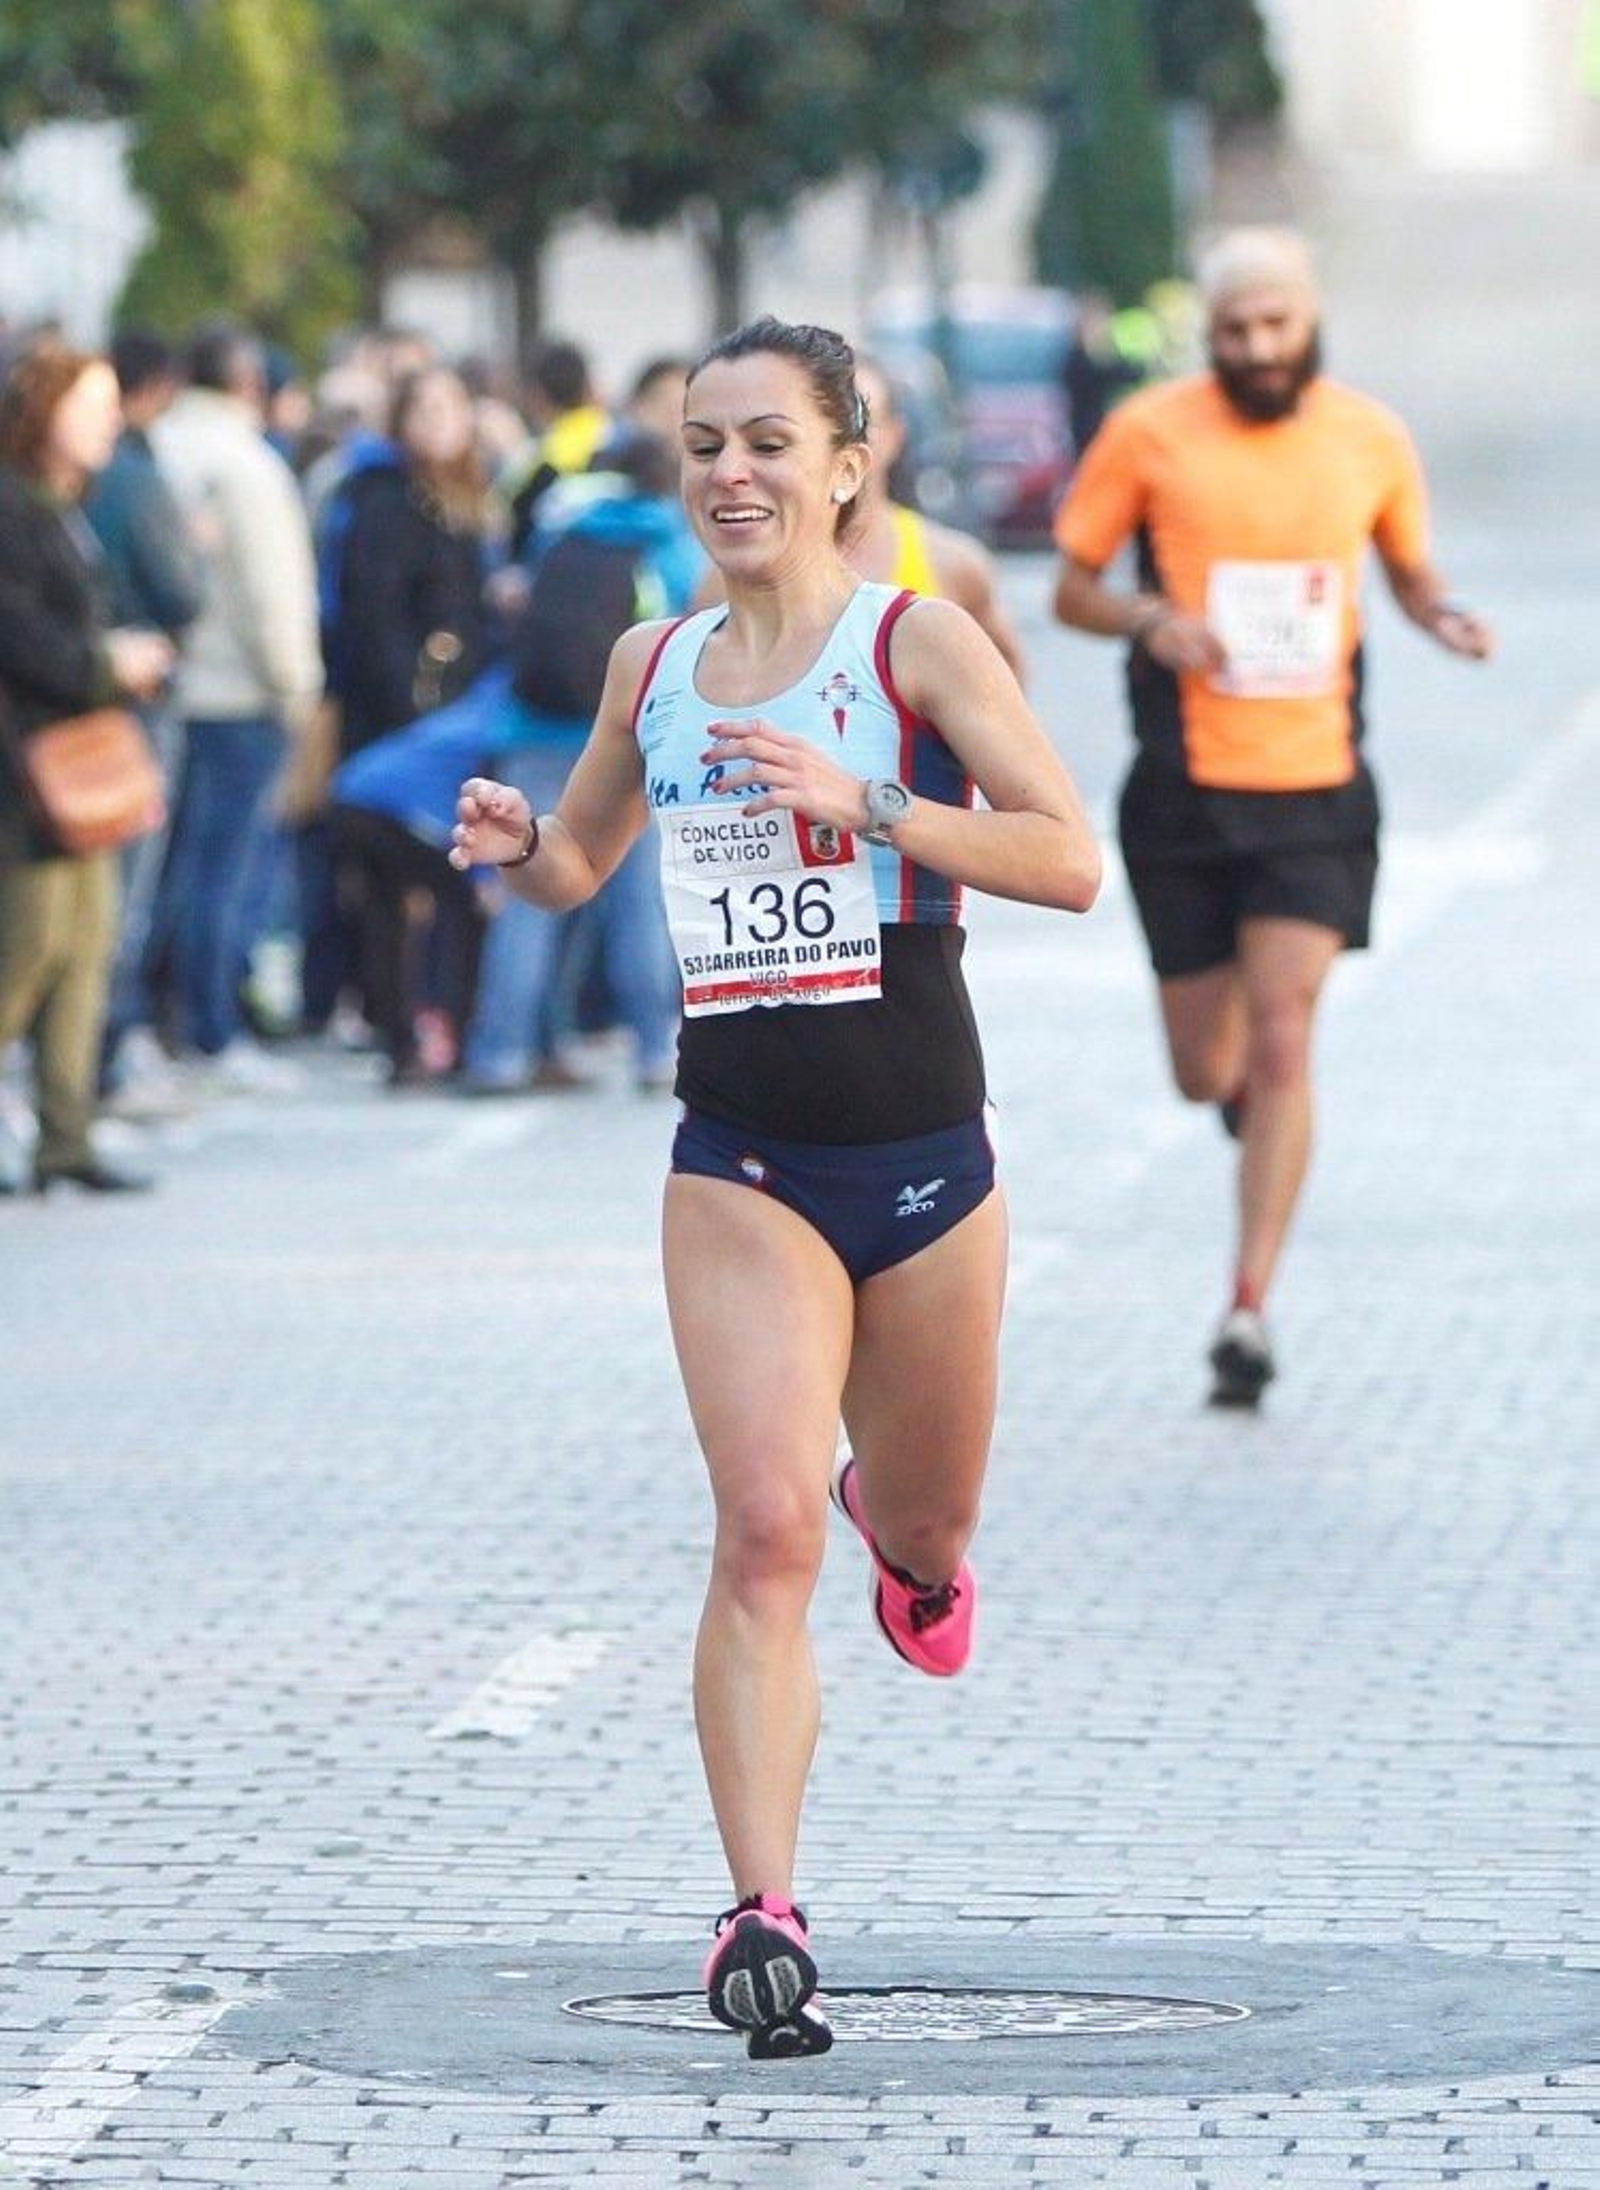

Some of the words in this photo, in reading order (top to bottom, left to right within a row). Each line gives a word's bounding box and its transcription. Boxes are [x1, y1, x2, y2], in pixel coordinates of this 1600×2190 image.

[681, 820, 779, 843] CONCELLO
[694, 848, 718, 864] DE
[724, 843, 770, 862] VIGO
[710, 877, 836, 946] 136
[795, 943, 822, 963] DO
[827, 937, 876, 960] PAVO
